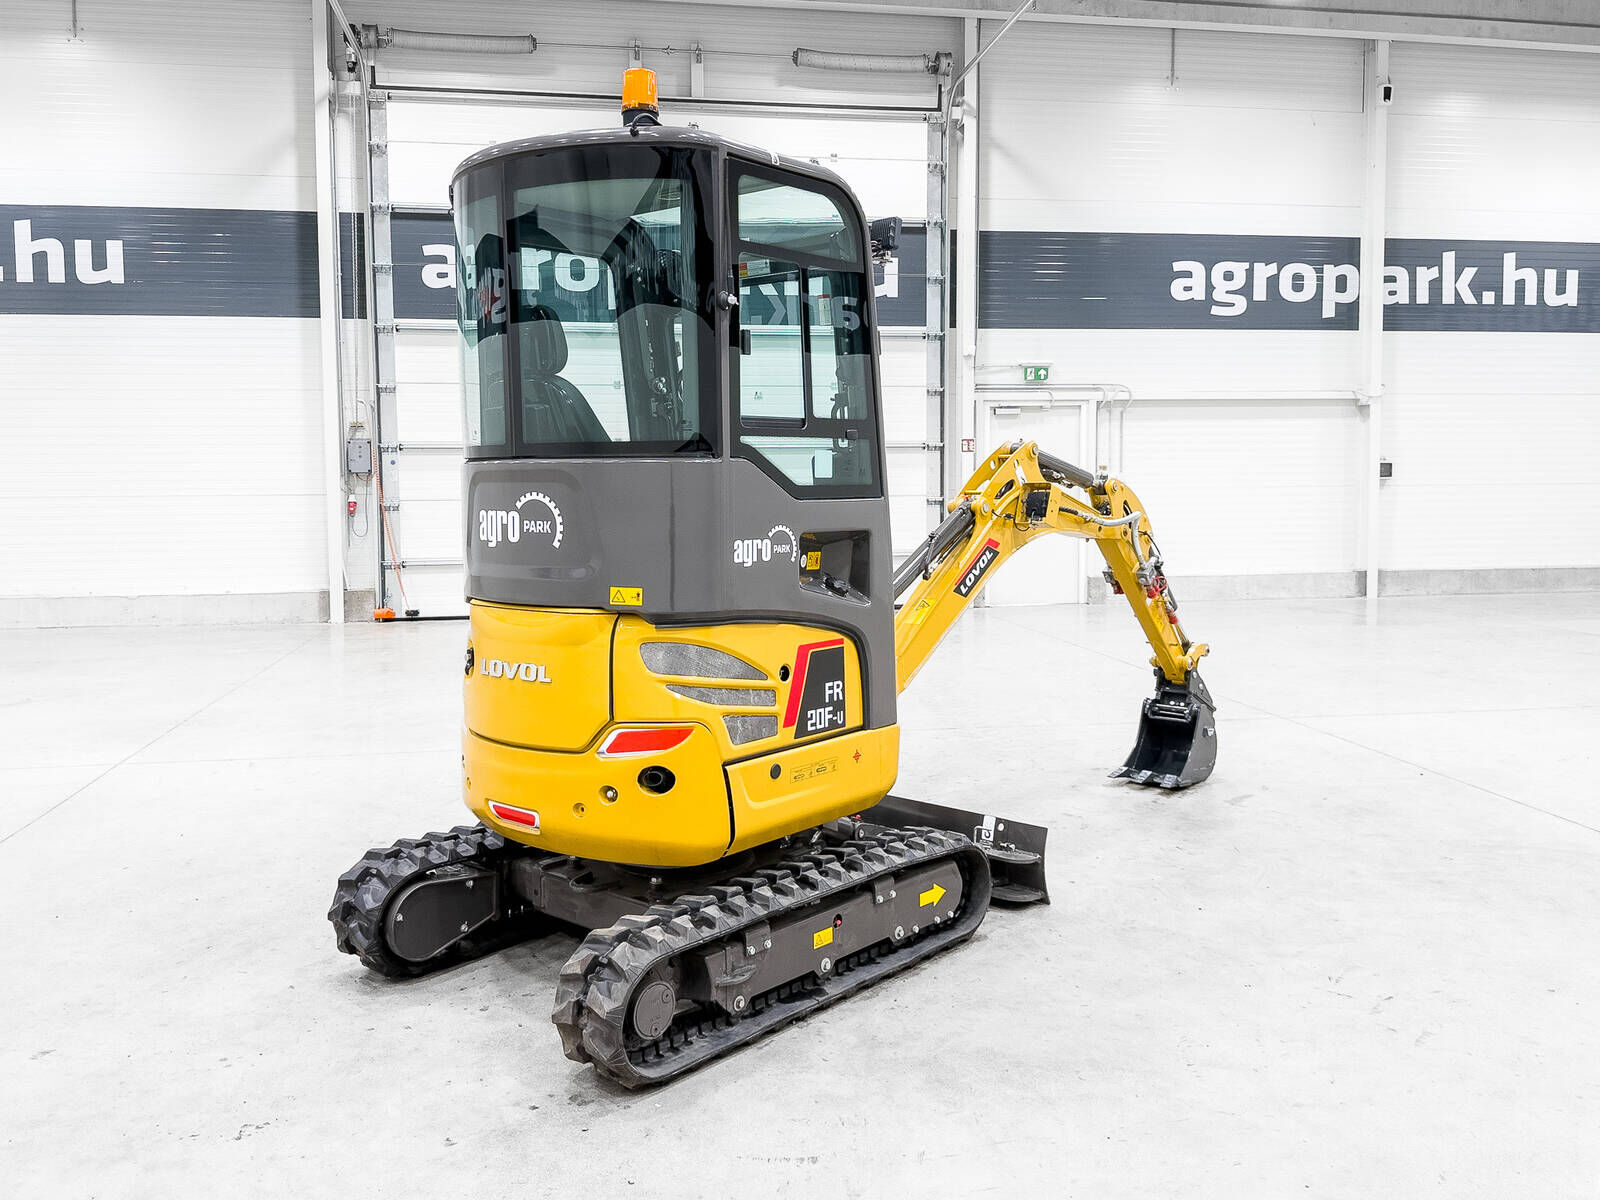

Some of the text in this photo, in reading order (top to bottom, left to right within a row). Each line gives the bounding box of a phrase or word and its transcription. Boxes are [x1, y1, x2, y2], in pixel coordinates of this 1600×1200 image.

[1169, 250, 1580, 319] agropark.hu
[479, 509, 552, 548] agro PARK
[733, 538, 792, 568] agro PARK
[959, 549, 994, 595] LOVOL
[480, 657, 553, 684] LOVOL
[824, 680, 844, 704] FR
